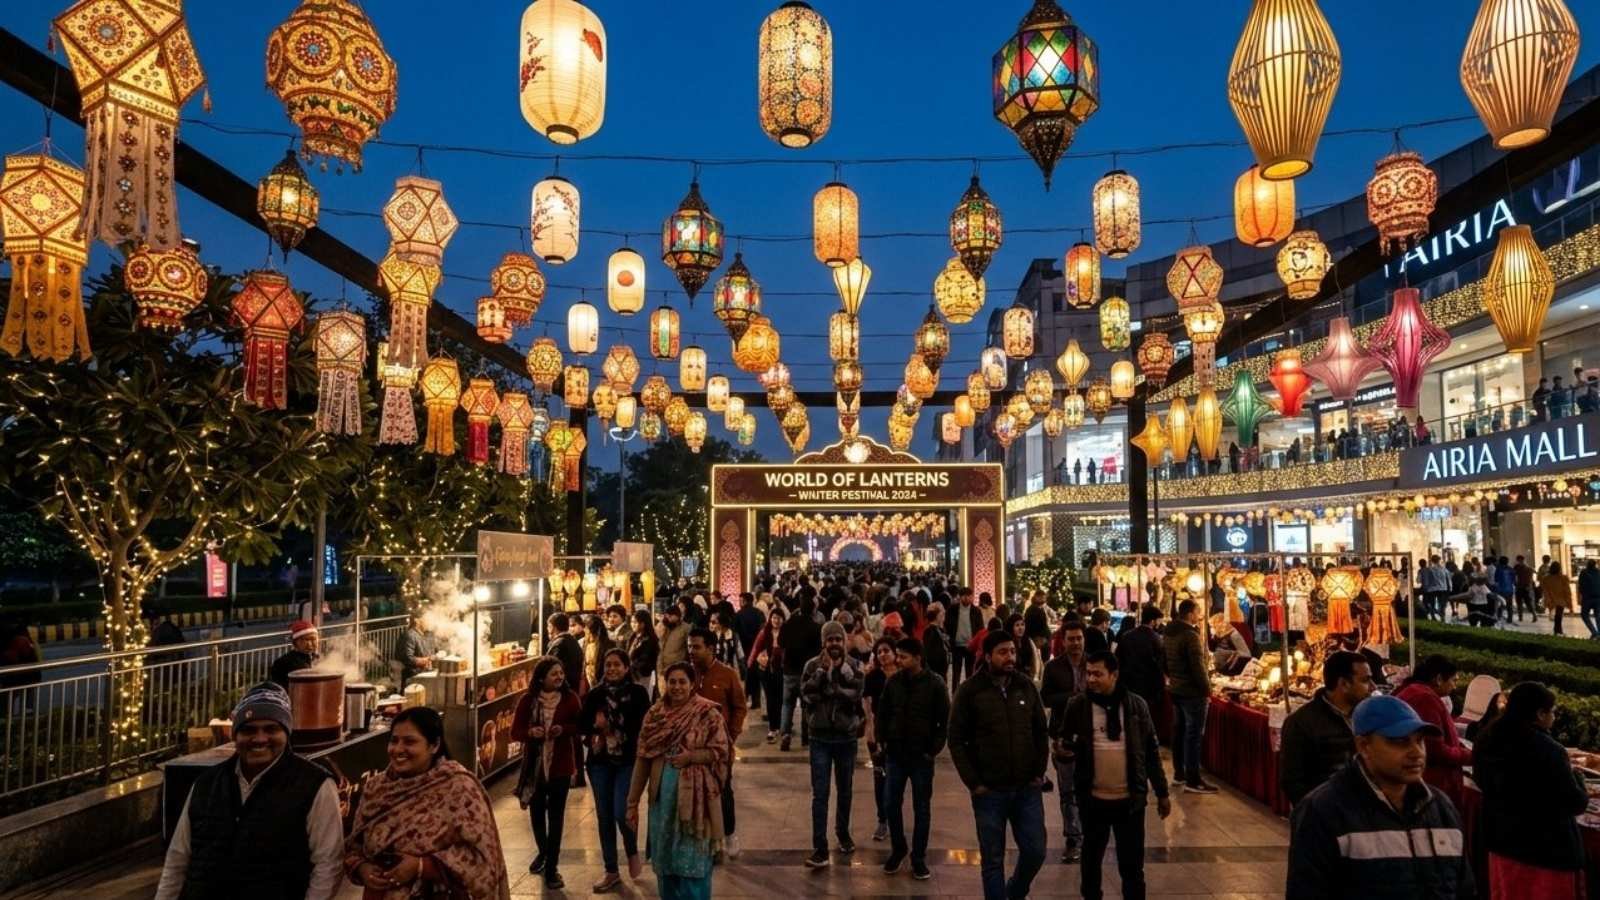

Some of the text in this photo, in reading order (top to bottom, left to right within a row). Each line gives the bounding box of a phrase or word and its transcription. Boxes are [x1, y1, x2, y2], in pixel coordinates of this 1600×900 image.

[1399, 198, 1517, 273] AIRIA
[764, 472, 950, 488] WORLD OF LANTERNS
[1423, 423, 1597, 481] AIRIA MALL
